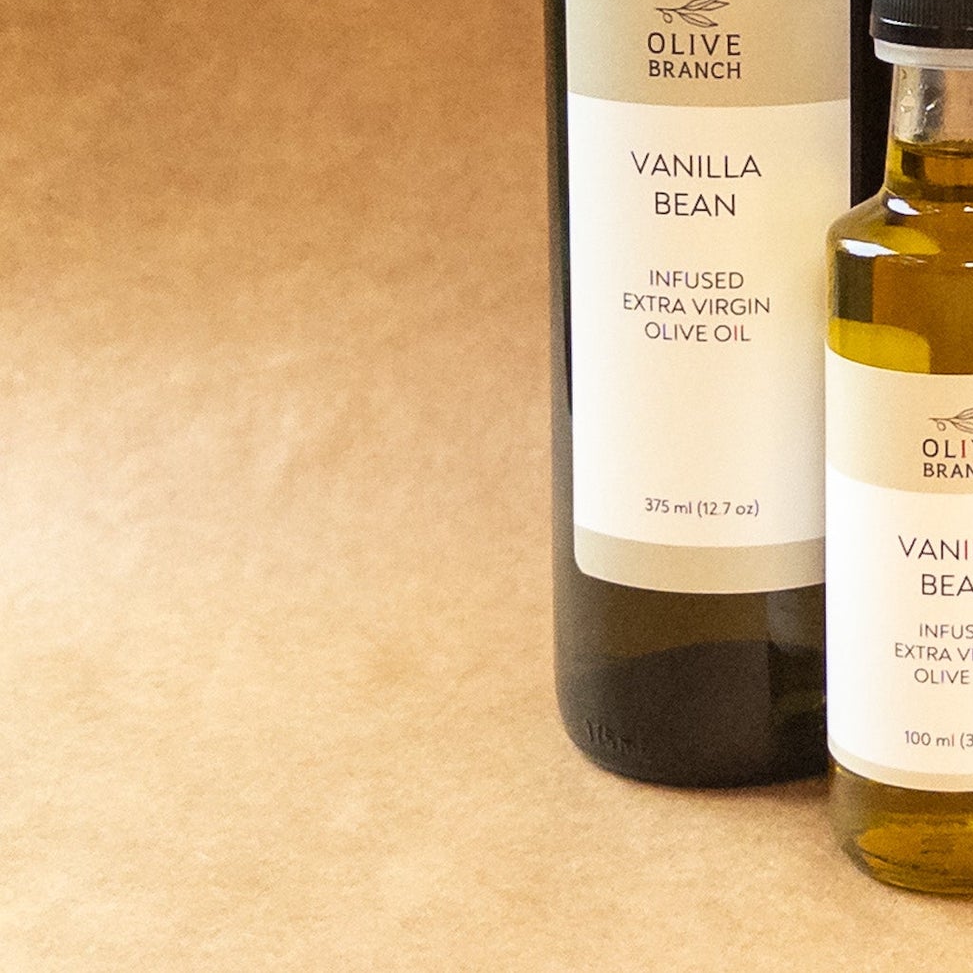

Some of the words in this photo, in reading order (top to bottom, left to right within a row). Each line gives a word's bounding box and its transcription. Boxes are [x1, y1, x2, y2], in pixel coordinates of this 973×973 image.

[647, 31, 742, 57] OLIVE
[648, 58, 742, 80] BRANCH
[630, 150, 763, 179] VANILLA
[654, 190, 736, 218] BEAN
[649, 269, 745, 290] INFUSED
[622, 291, 687, 315] EXTRA
[691, 297, 771, 316] VIRGIN
[644, 321, 708, 343] OLIVE
[713, 324, 751, 343] OIL
[645, 497, 670, 514] 375
[673, 500, 693, 515] ml
[735, 499, 760, 518] oz)
[894, 641, 953, 662] EXTRA
[913, 667, 969, 685] OLIVE
[904, 730, 932, 747] 100
[935, 733, 955, 747] ml
